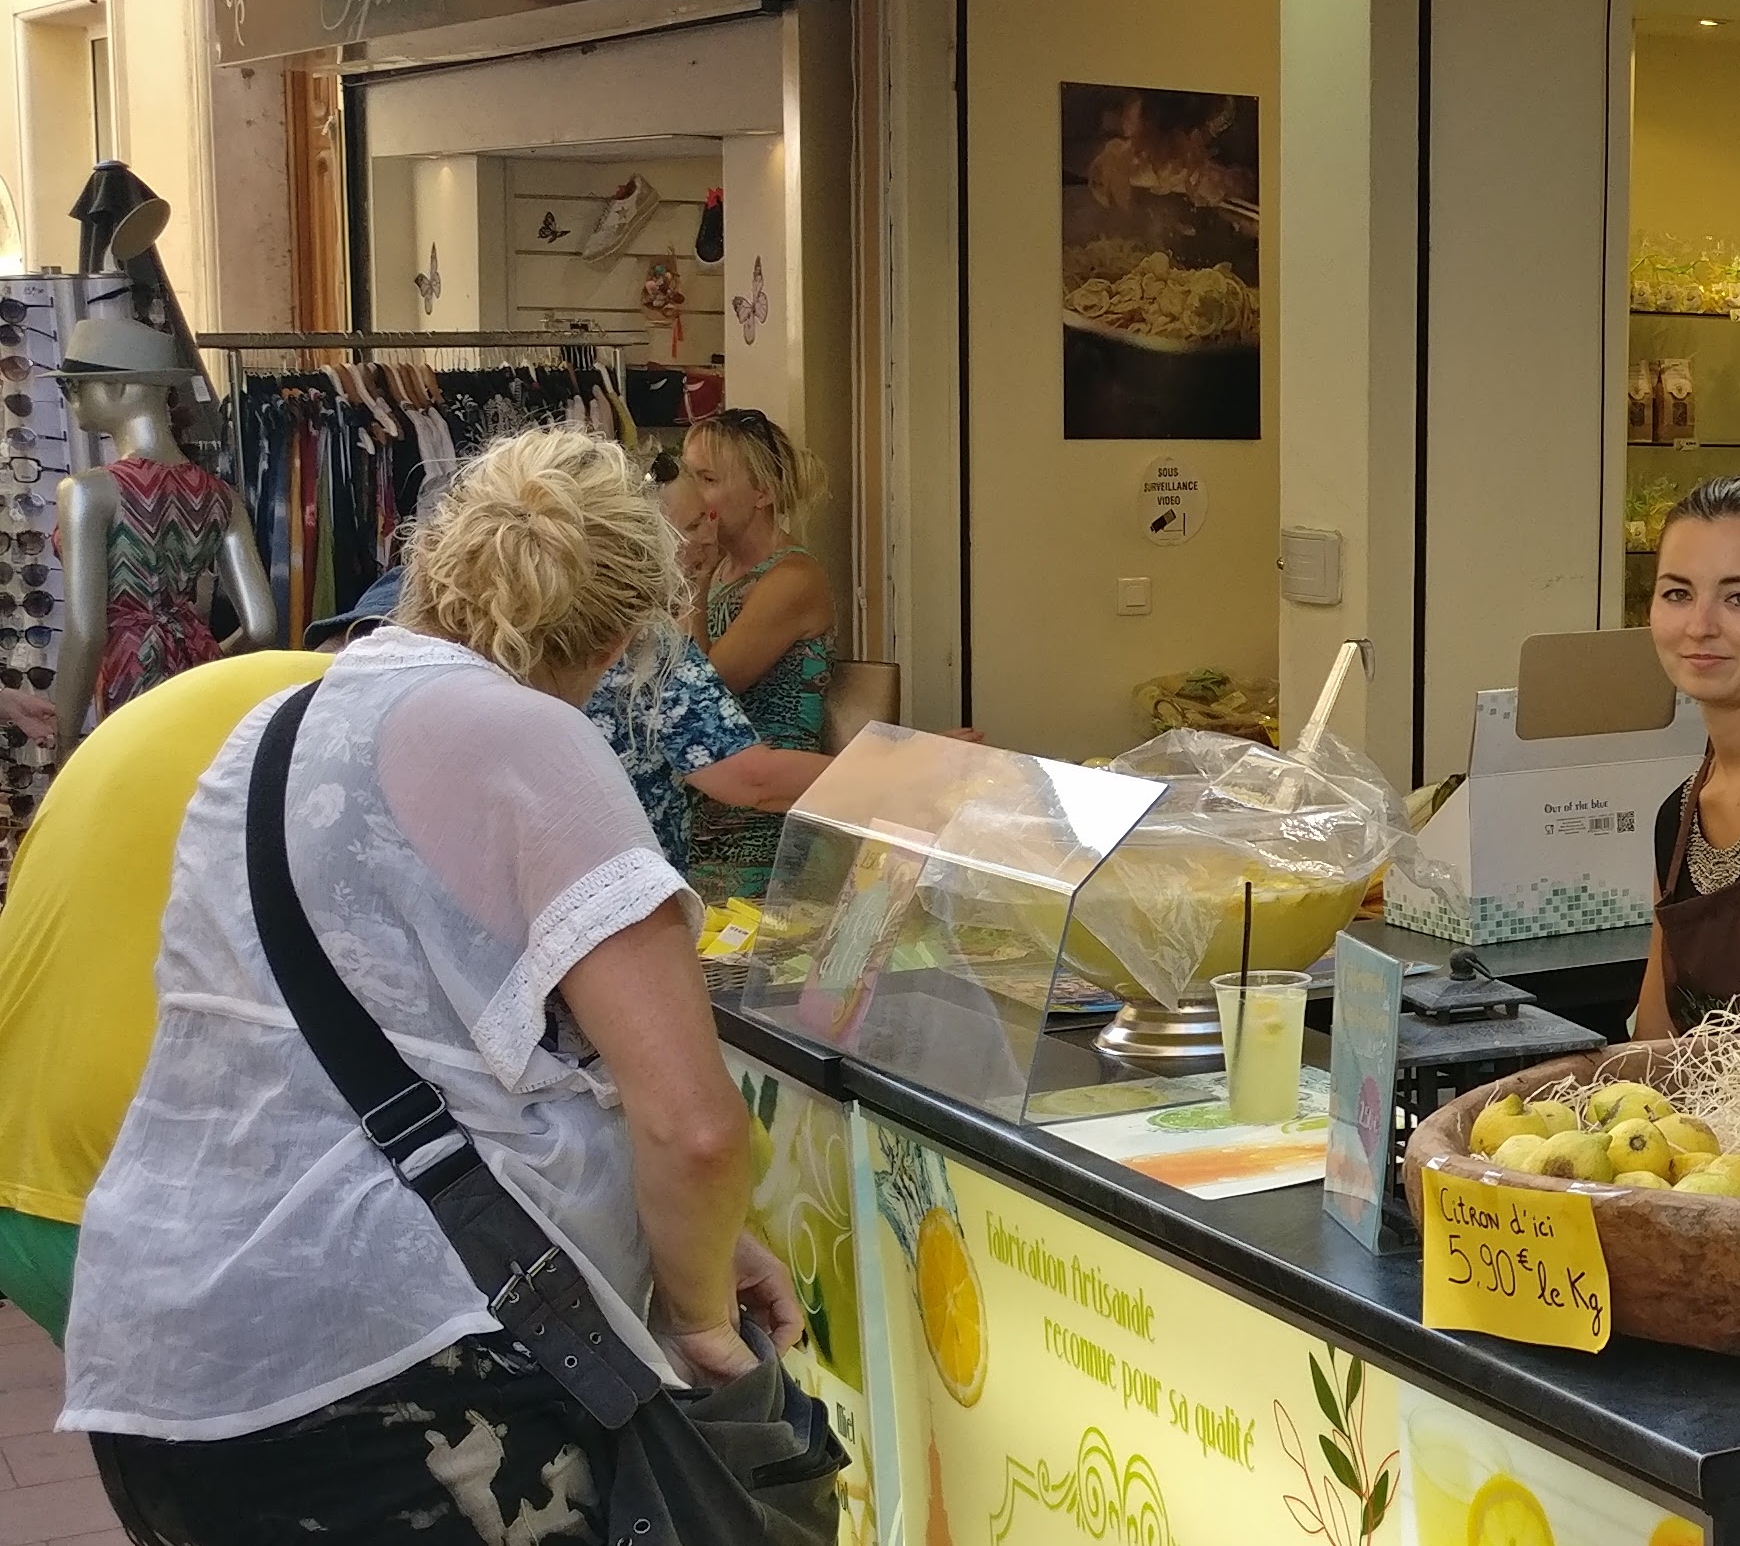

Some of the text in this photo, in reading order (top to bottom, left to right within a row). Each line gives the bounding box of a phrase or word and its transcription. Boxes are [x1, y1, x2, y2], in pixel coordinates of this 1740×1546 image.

[1157, 467, 1179, 478] SOUS
[1143, 480, 1199, 493] SURVEILLANCE
[1157, 495, 1181, 506] VIDEO
[1563, 801, 1573, 812] of
[1510, 1203, 1555, 1238] d'ici
[986, 1209, 1156, 1343] Fabrication Artisanale
[1537, 1260, 1565, 1308] le
[1043, 1314, 1256, 1473] reconnue pour sa qualité
